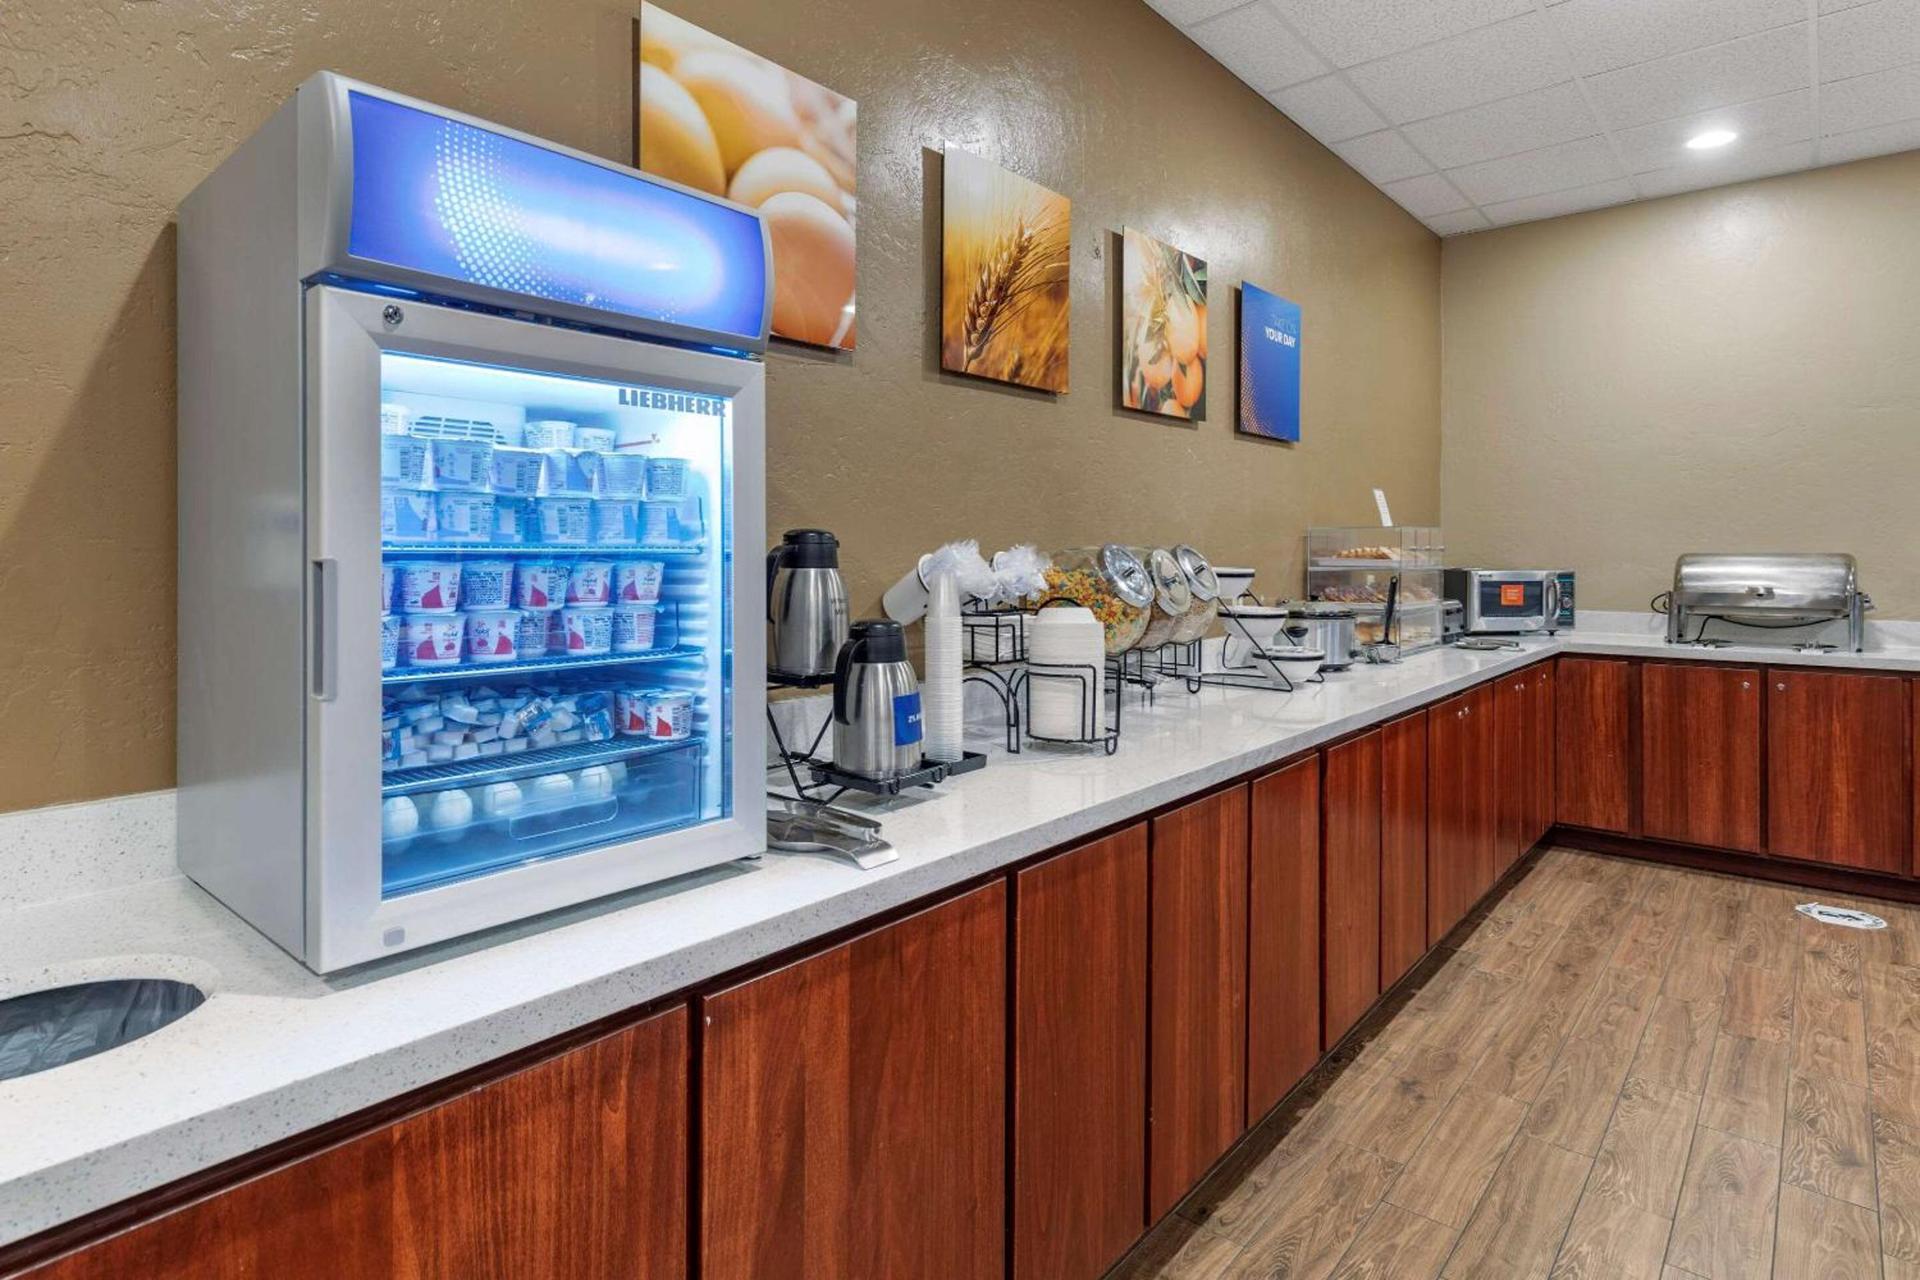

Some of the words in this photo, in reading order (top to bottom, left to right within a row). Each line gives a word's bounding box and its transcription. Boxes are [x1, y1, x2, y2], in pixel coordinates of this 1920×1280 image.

[1264, 326, 1283, 344] YOUR
[1284, 334, 1296, 348] DAY
[618, 388, 726, 417] LIEBHERR
